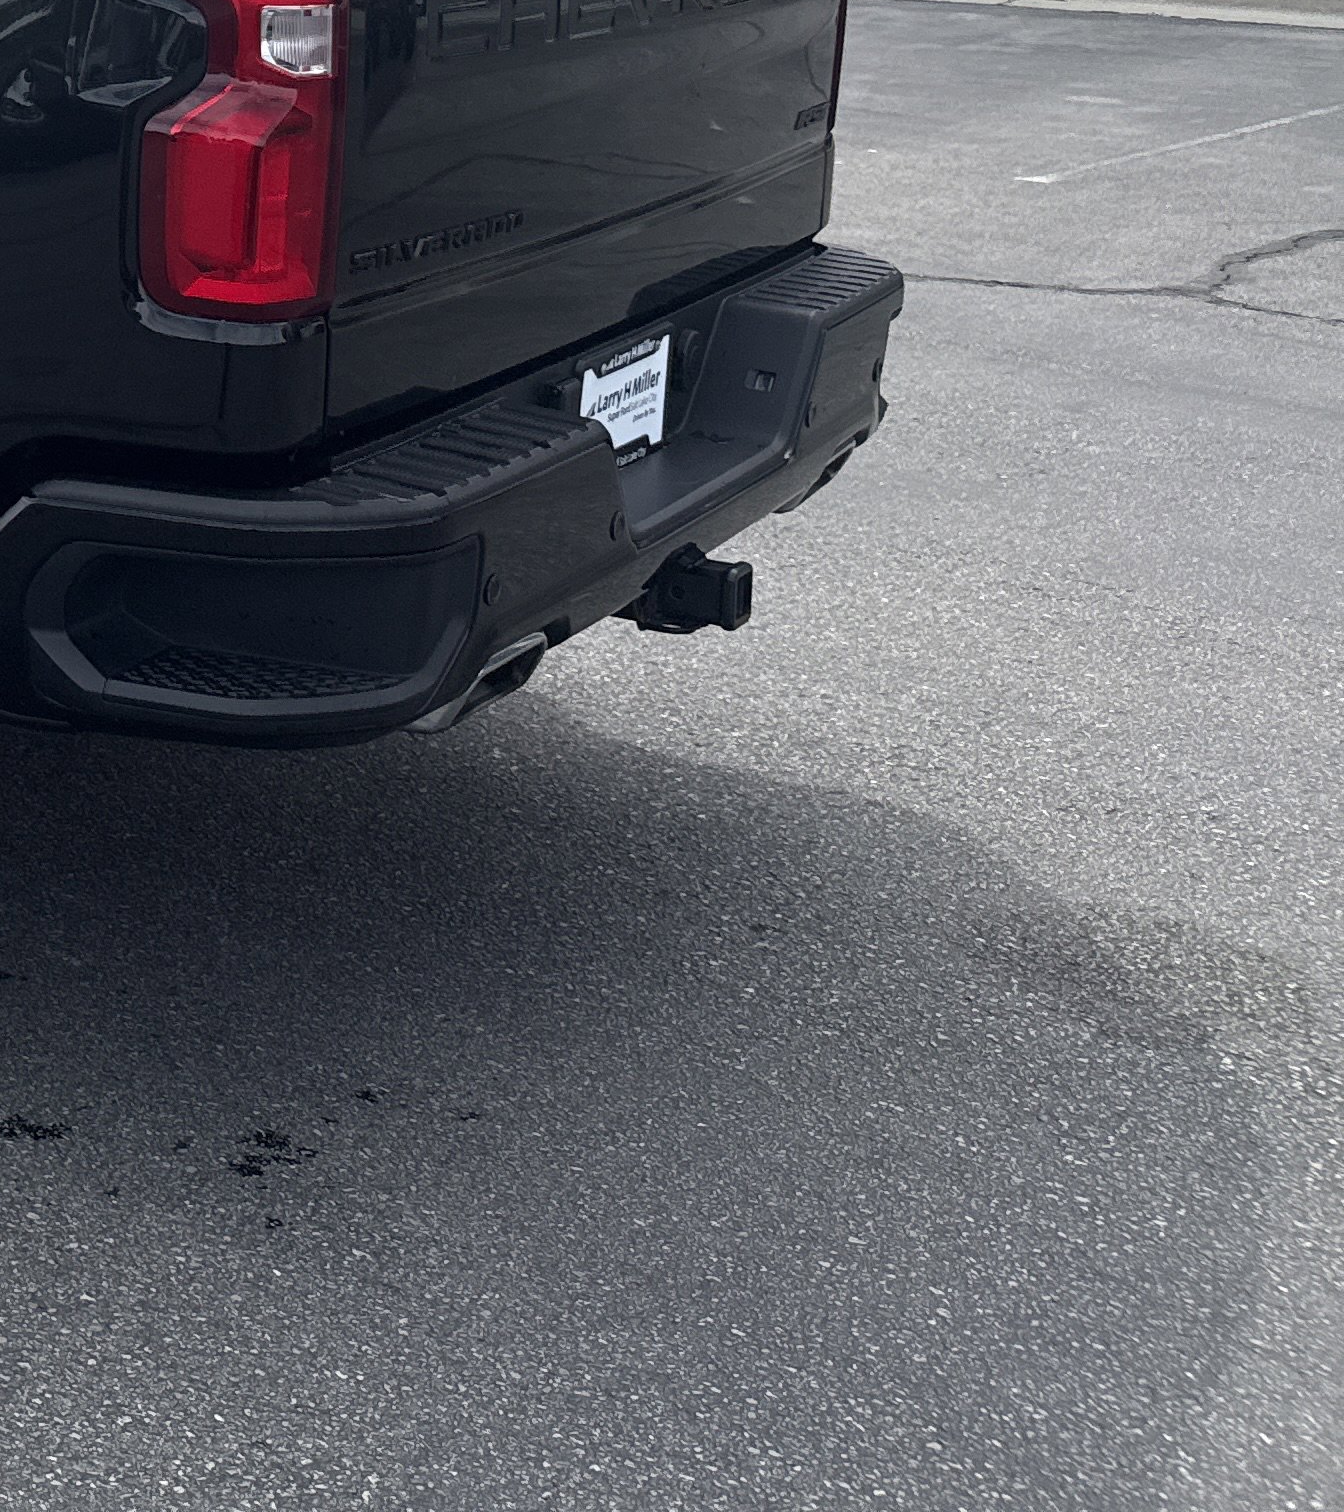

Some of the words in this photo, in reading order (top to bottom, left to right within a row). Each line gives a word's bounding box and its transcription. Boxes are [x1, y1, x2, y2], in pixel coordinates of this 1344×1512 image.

[349, 209, 524, 275] SILVERADO
[597, 388, 623, 413] Larry
[623, 380, 632, 401] H
[632, 369, 660, 398] Miller
